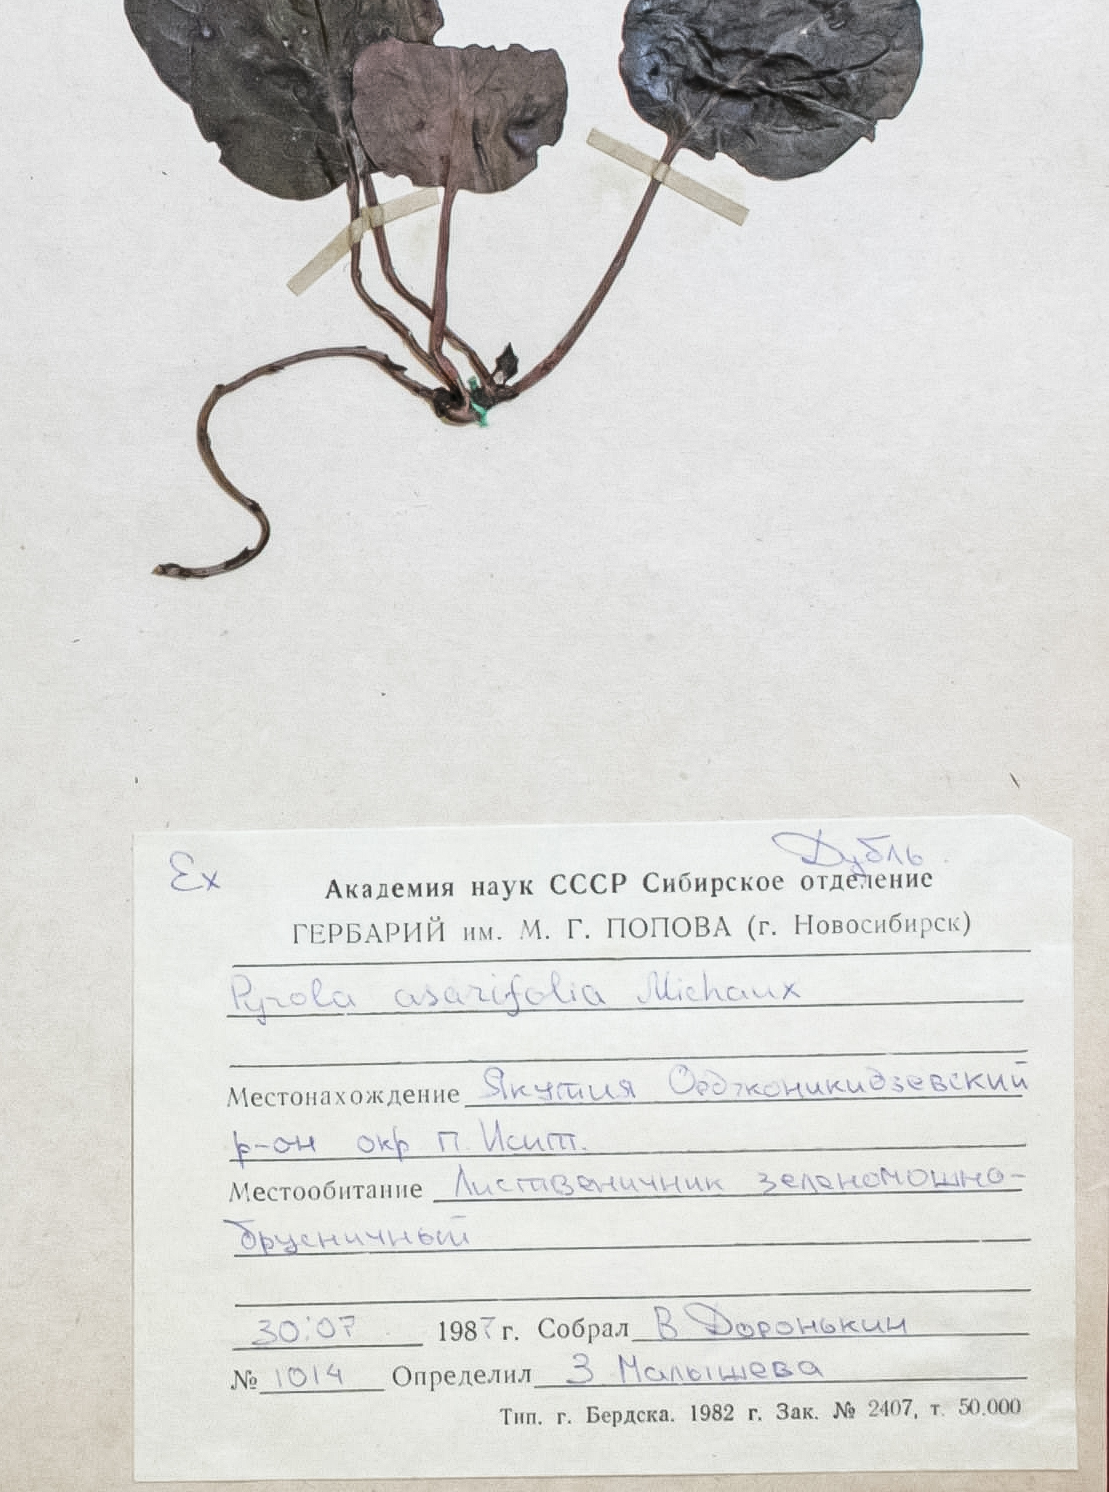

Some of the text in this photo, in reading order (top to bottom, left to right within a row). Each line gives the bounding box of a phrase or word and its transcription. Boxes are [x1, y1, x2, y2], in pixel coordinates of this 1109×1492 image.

[771, 829, 923, 886] Дубль
[325, 870, 934, 901] Академия наук СССР Сибирское отделение
[292, 910, 972, 945] ГЕРБАРИЙ им. М. Г. ПОПОВА (г. Новосибирск)
[230, 968, 802, 1026] Pyrola asarifolia Michaux
[227, 1085, 461, 1109] Местонахождение
[483, 1066, 637, 1103] Якутия
[232, 1130, 317, 1169] р-он
[229, 1178, 423, 1203] Местообитание
[537, 1317, 630, 1344] Собрал
[231, 1370, 258, 1391] №
[275, 1362, 344, 1388] 1014
[392, 1365, 532, 1394] Определил
[617, 1353, 824, 1385] Малышева
[500, 1397, 1022, 1427] Тип. г. Бердска. 1982 г. Зак. № 2407, т. 50.000
